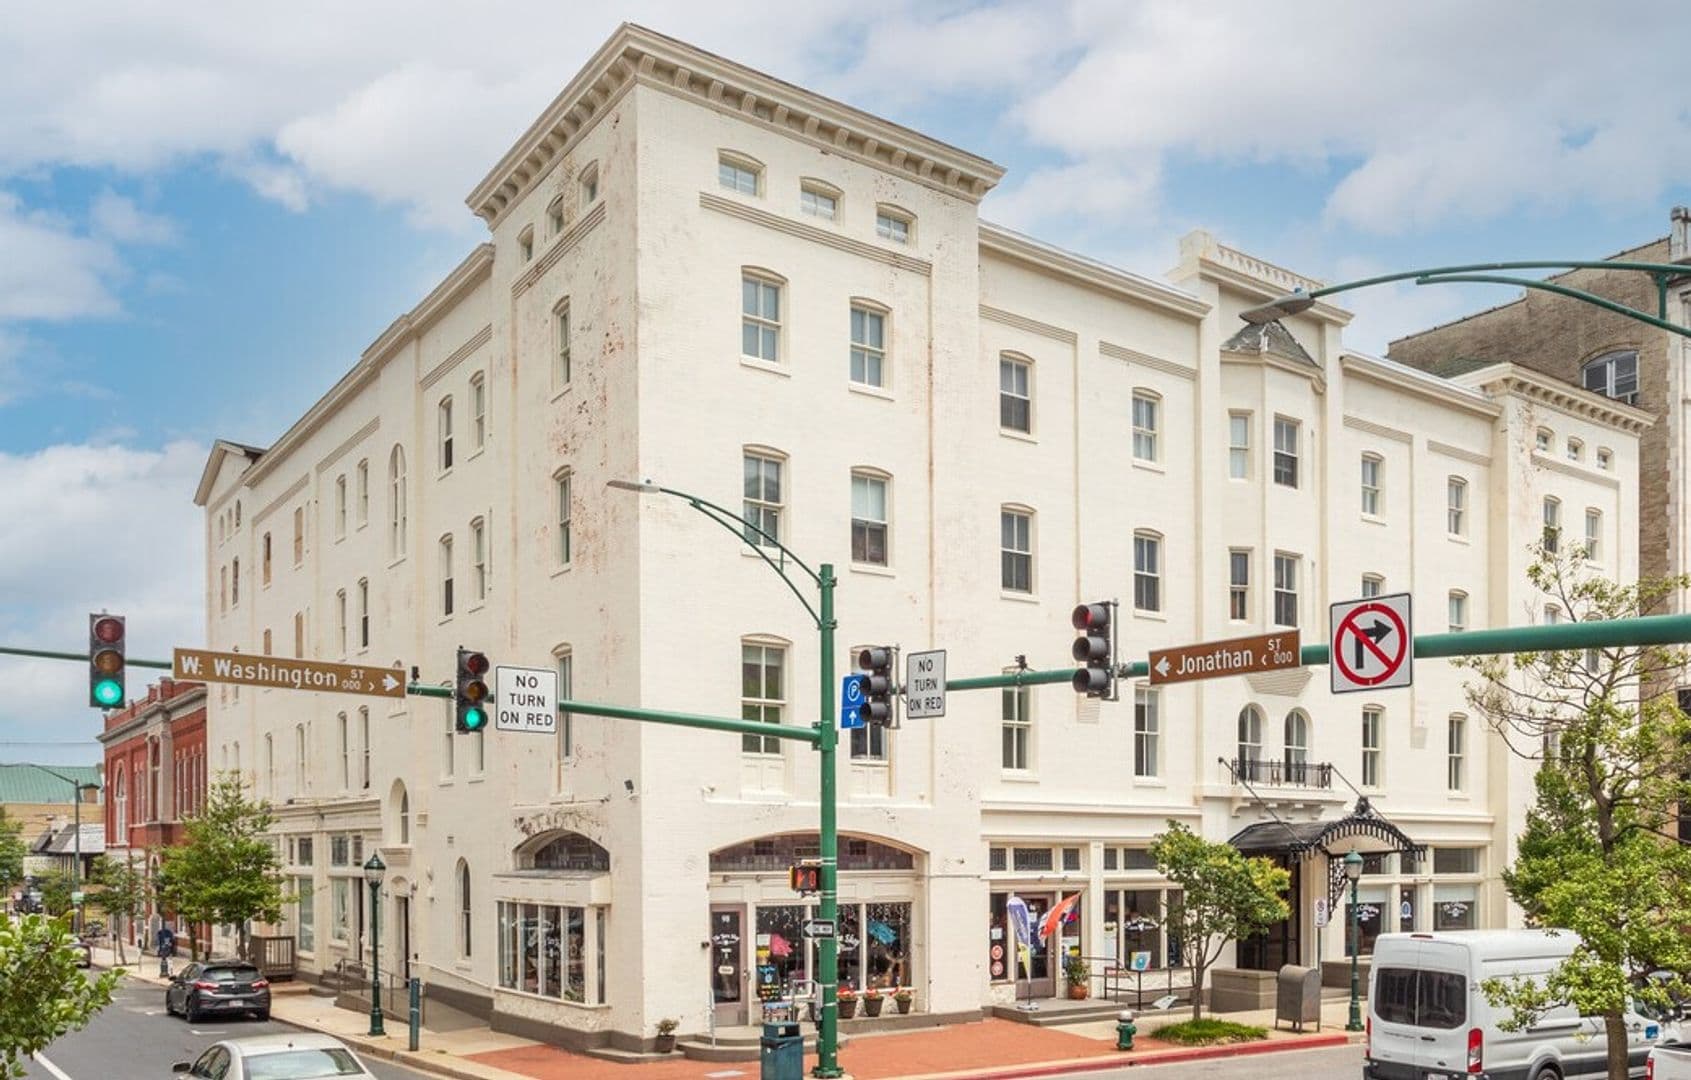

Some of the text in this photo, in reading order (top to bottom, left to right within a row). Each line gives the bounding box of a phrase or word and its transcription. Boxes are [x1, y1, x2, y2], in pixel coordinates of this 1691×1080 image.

[1267, 638, 1282, 651] ST
[1176, 649, 1254, 675] Jonathan
[1273, 651, 1293, 664] 000
[214, 658, 337, 688] Washington
[350, 668, 365, 679] ST
[918, 659, 933, 673] NO
[341, 679, 361, 690] 000
[516, 675, 538, 688] NO
[914, 678, 938, 692] TURN
[509, 692, 545, 707] TURN
[910, 696, 942, 711] ON RED
[500, 711, 553, 726] ON RED
